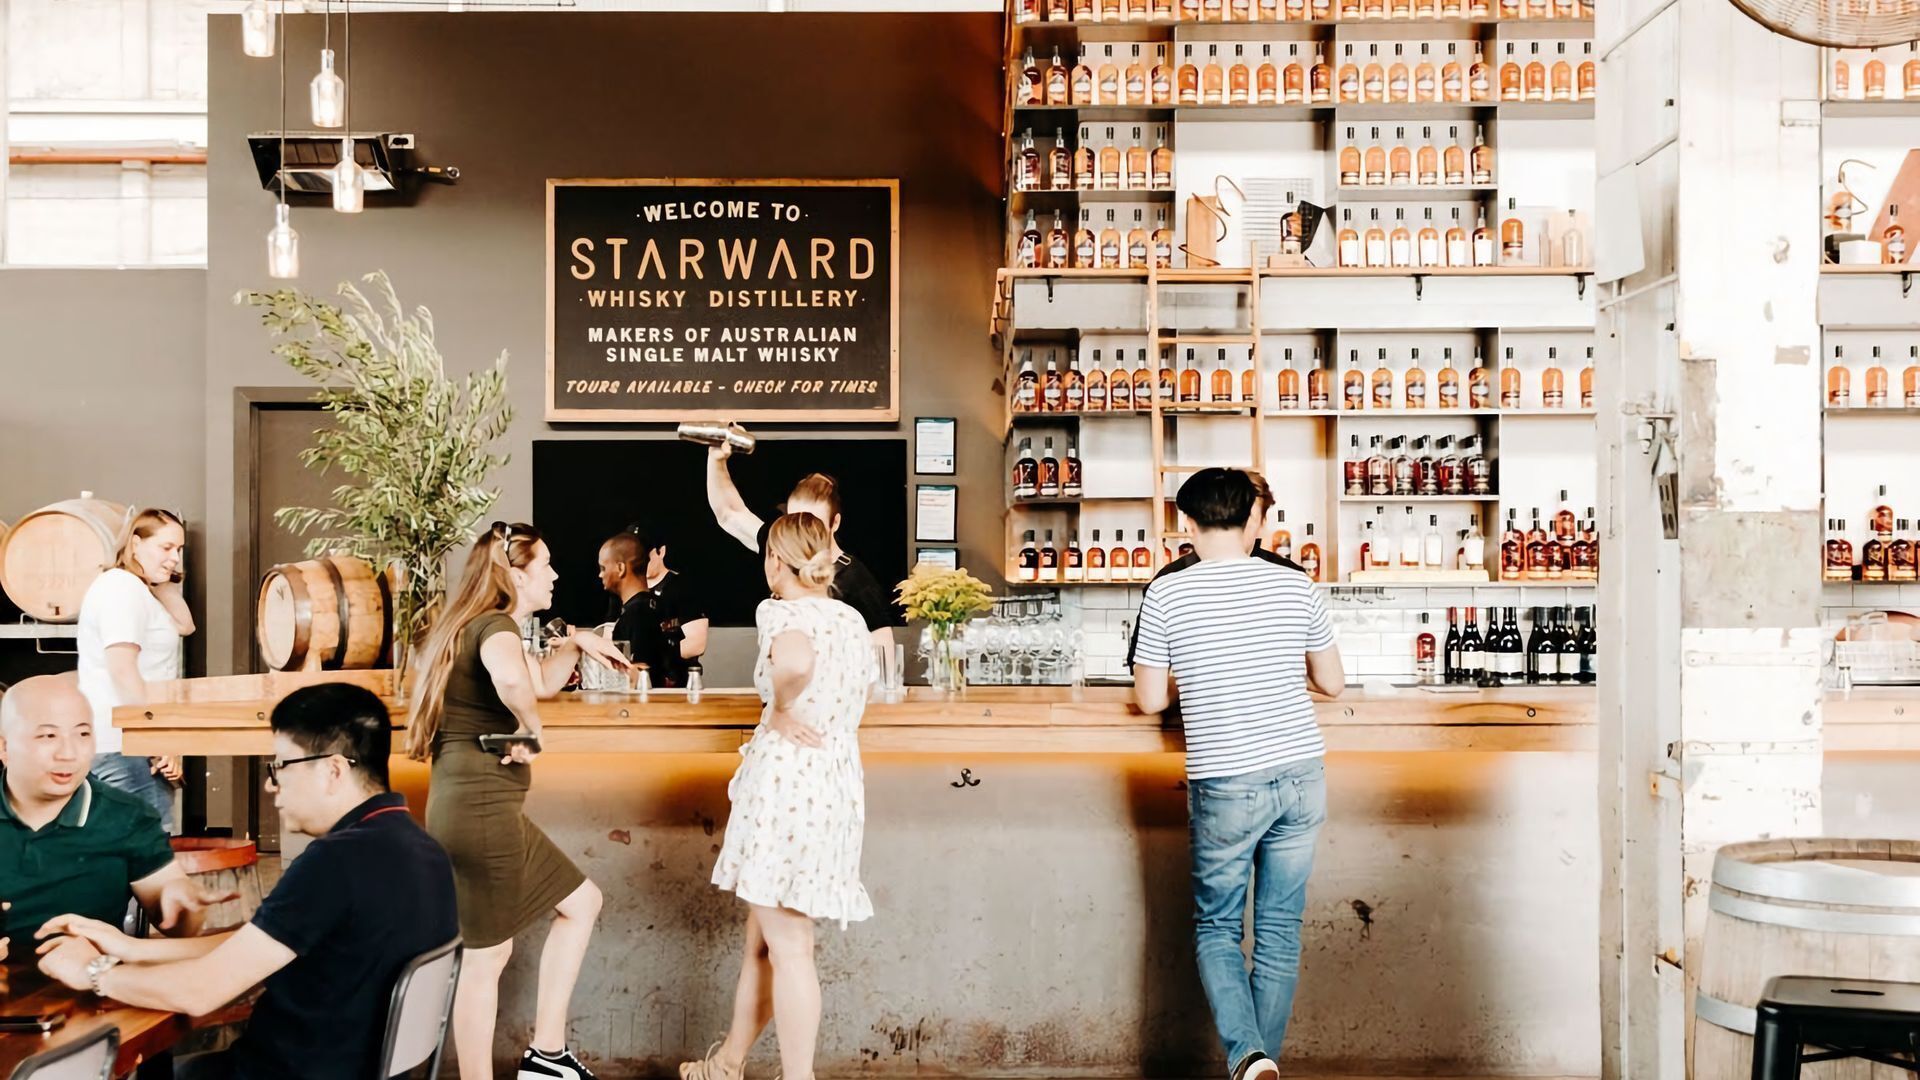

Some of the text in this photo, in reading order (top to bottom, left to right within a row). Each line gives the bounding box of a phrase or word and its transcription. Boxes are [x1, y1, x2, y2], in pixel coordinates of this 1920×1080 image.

[643, 200, 801, 223] WELCOME TO
[570, 237, 875, 281] STARWARD
[587, 289, 858, 308] WHISKY DISTILLERY
[588, 327, 857, 343] MAKERS OF AUSTRALIAN
[606, 347, 840, 363] SINGLE MALT WHISKY
[566, 379, 621, 394] TOURS
[626, 379, 713, 394] AVAILABLE
[733, 379, 787, 394] CHECK
[790, 379, 824, 394] FOR
[829, 379, 879, 394] TIMES
